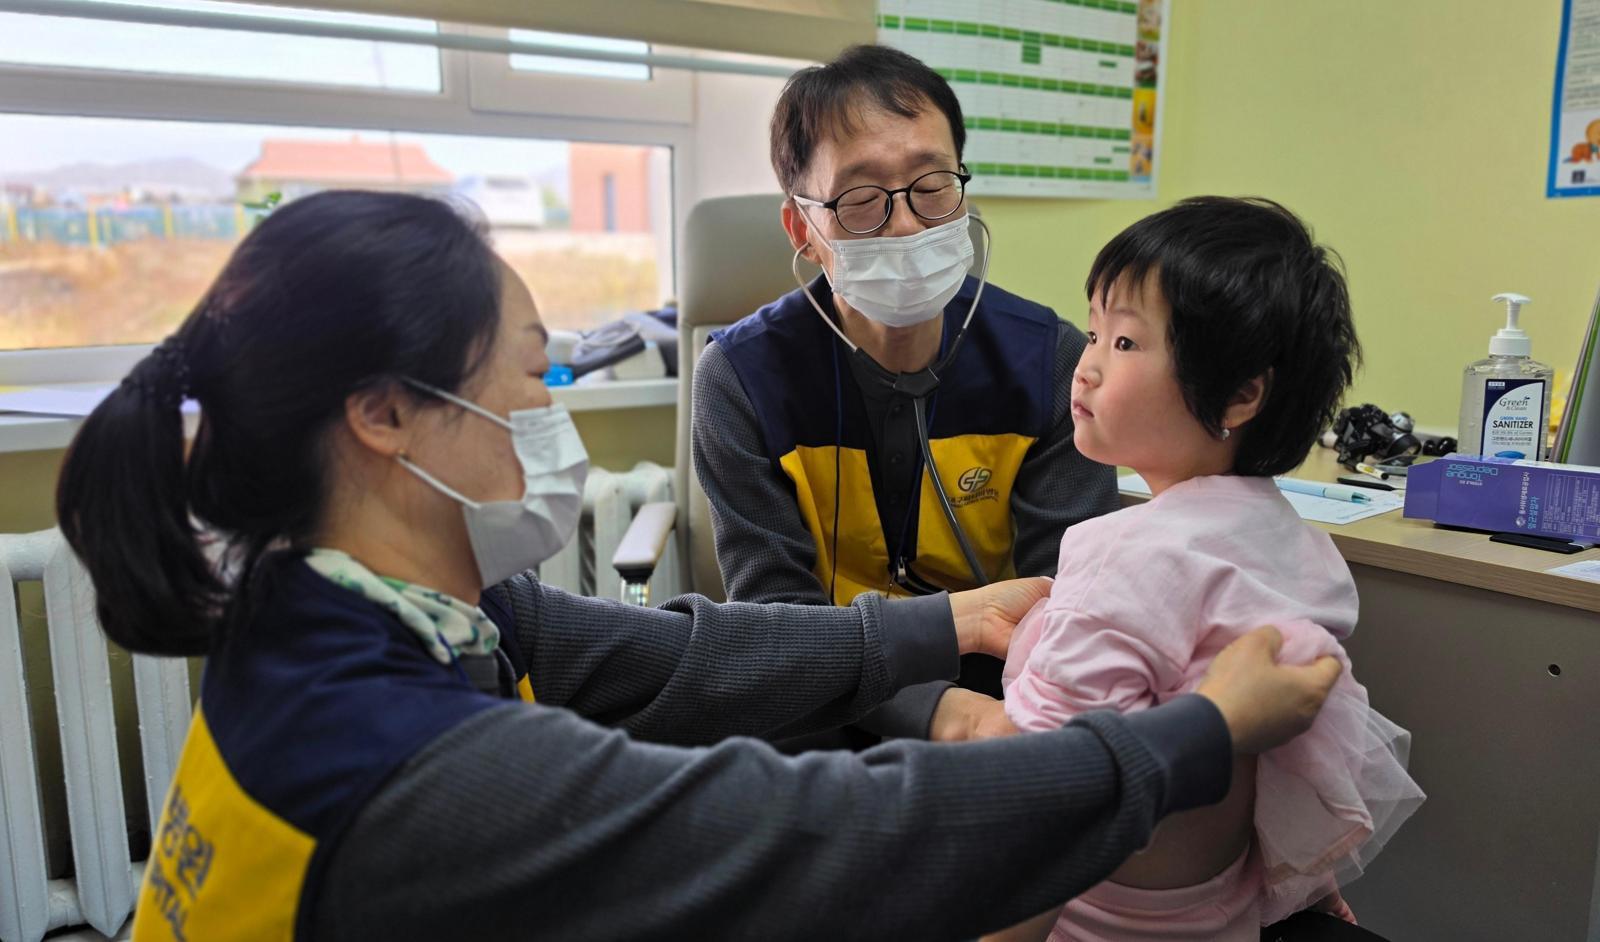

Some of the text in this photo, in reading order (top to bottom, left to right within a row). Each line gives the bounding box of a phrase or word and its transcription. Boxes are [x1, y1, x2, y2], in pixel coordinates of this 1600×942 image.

[1499, 396, 1529, 407] Green
[1492, 420, 1534, 429] SANITIZER
[1447, 463, 1499, 476] Depressor
[1446, 470, 1482, 481] Tongue
